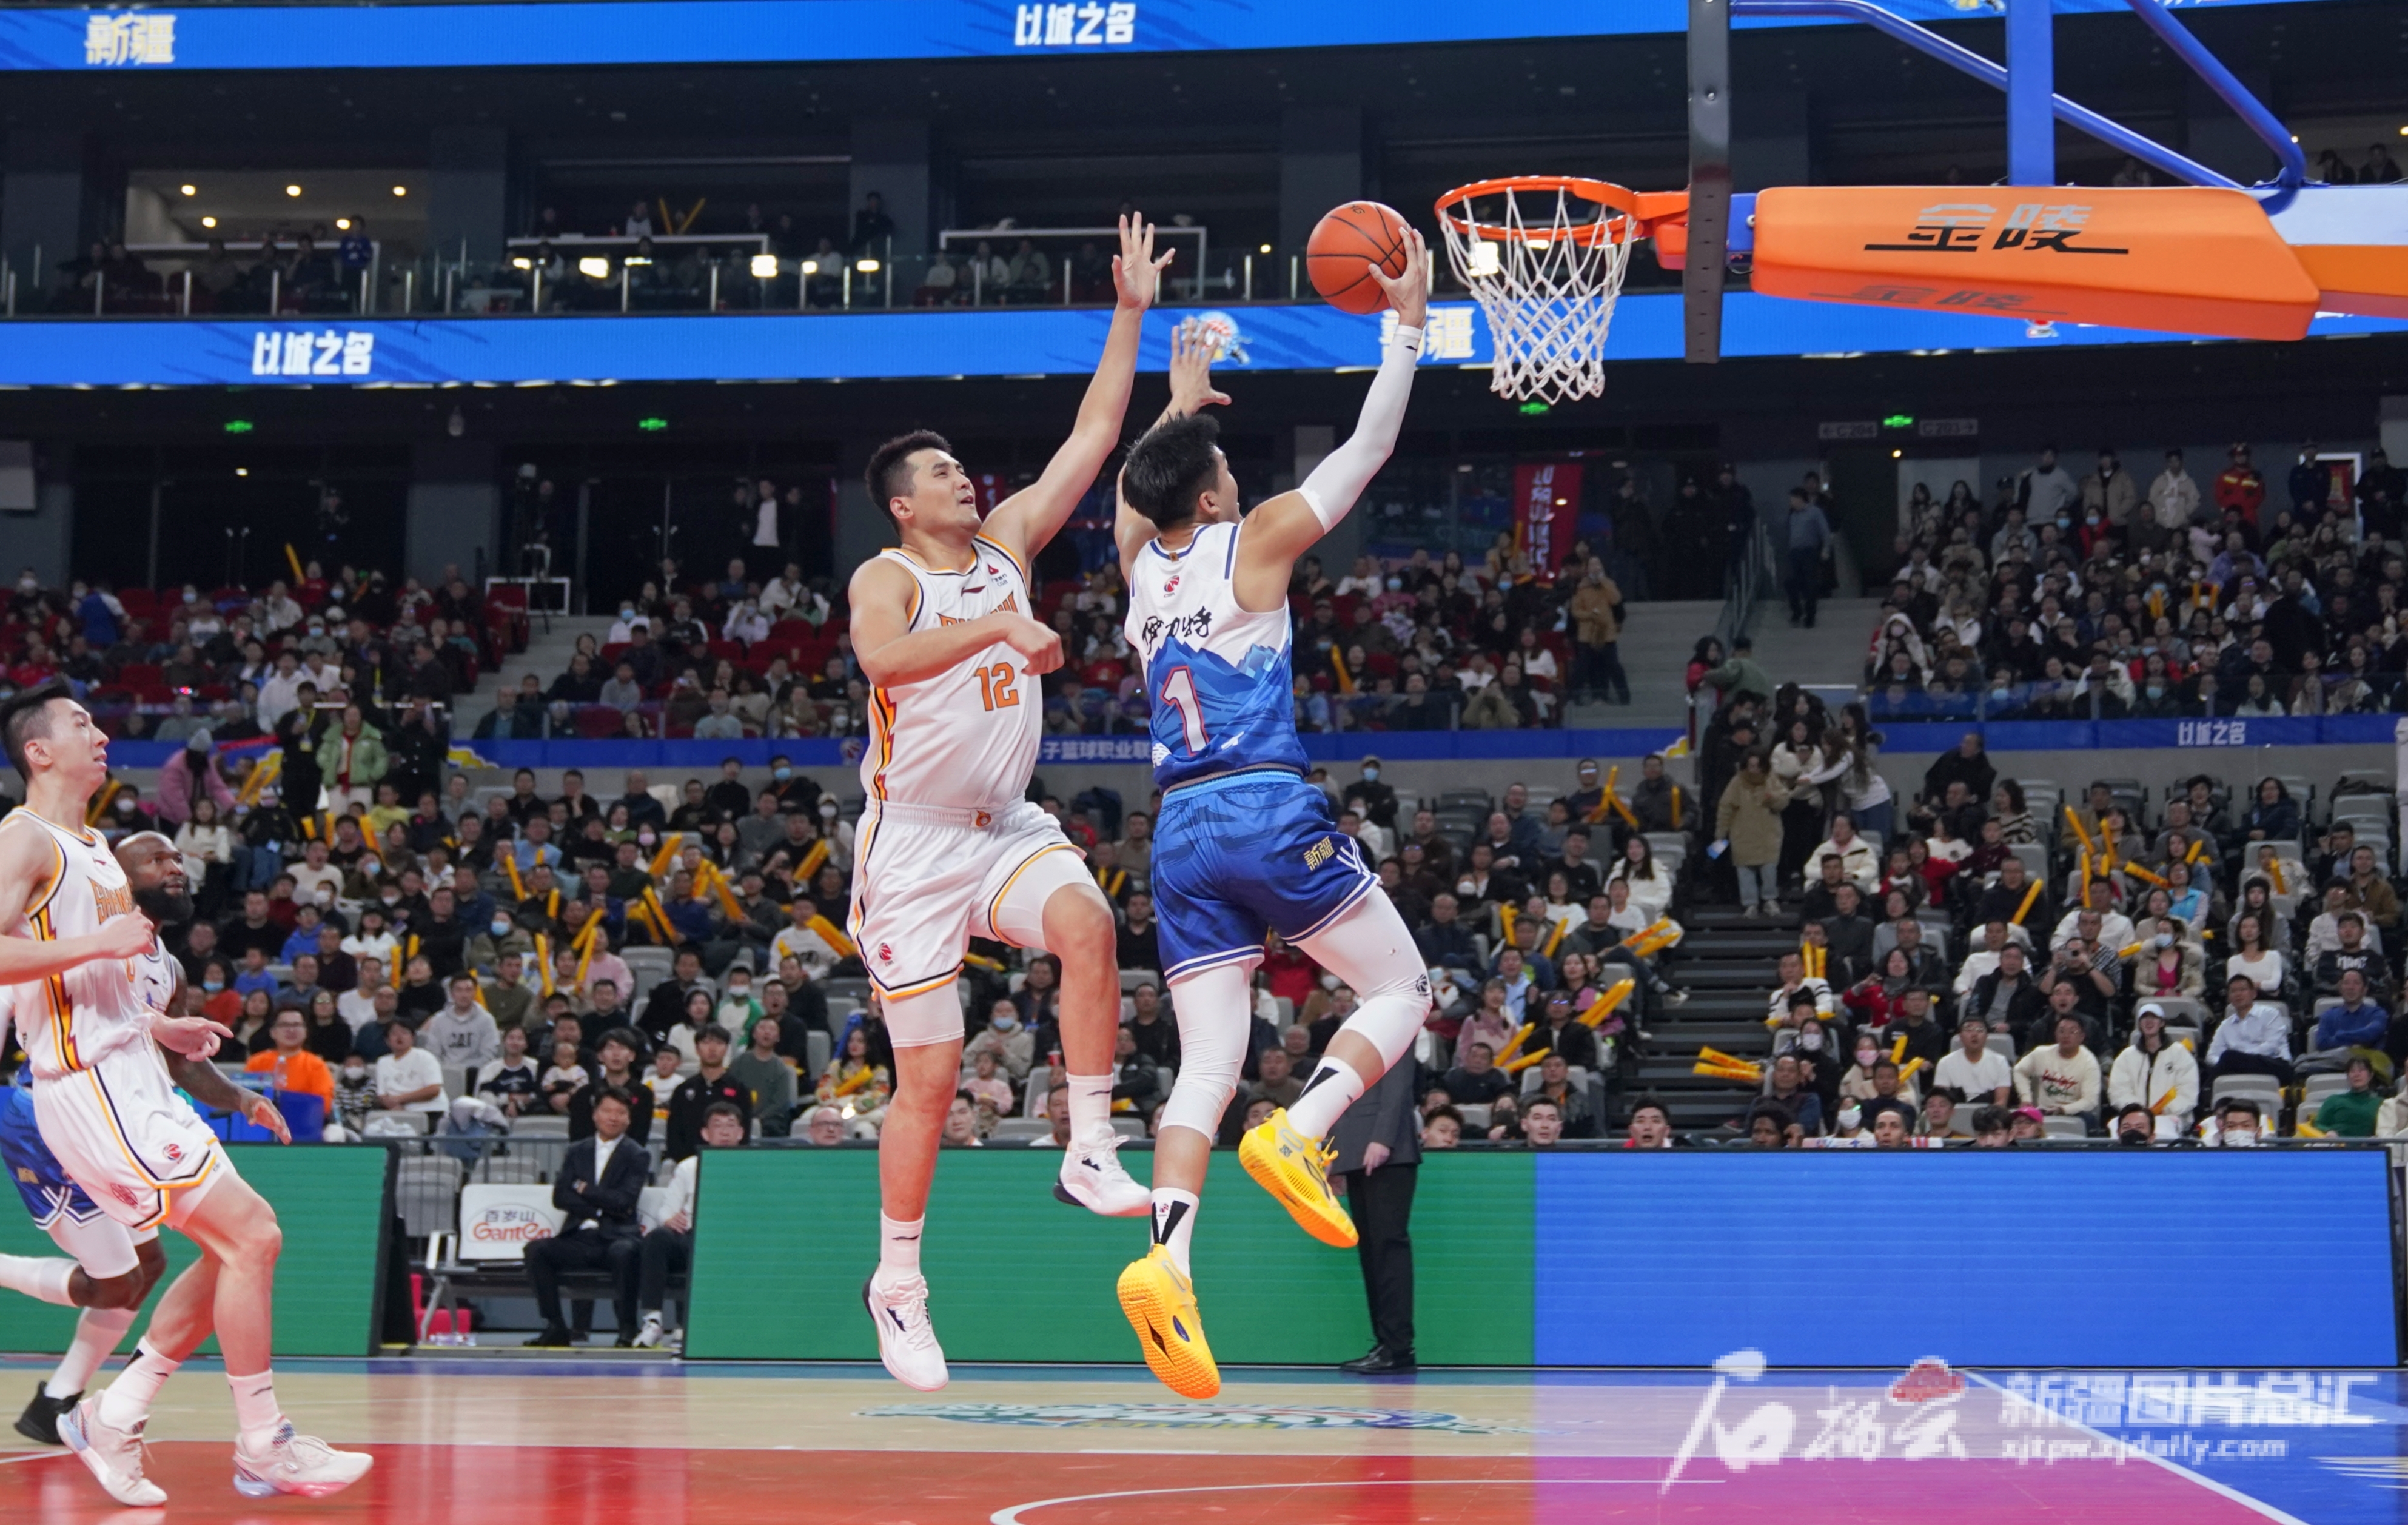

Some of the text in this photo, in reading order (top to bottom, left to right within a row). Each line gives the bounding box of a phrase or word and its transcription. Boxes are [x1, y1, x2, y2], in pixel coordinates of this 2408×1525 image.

[84, 11, 176, 66] 新疆
[1015, 1, 1136, 46] 以城之名
[1864, 203, 2129, 255] 金陵
[252, 329, 374, 375] 以城之名
[973, 662, 1020, 712] 12
[1160, 665, 1210, 757] 1
[2178, 720, 2247, 746] 以城之名
[1039, 740, 1152, 760] 子篮球职业联
[1303, 835, 1335, 871] 新疆
[485, 1210, 535, 1223] 百岁山
